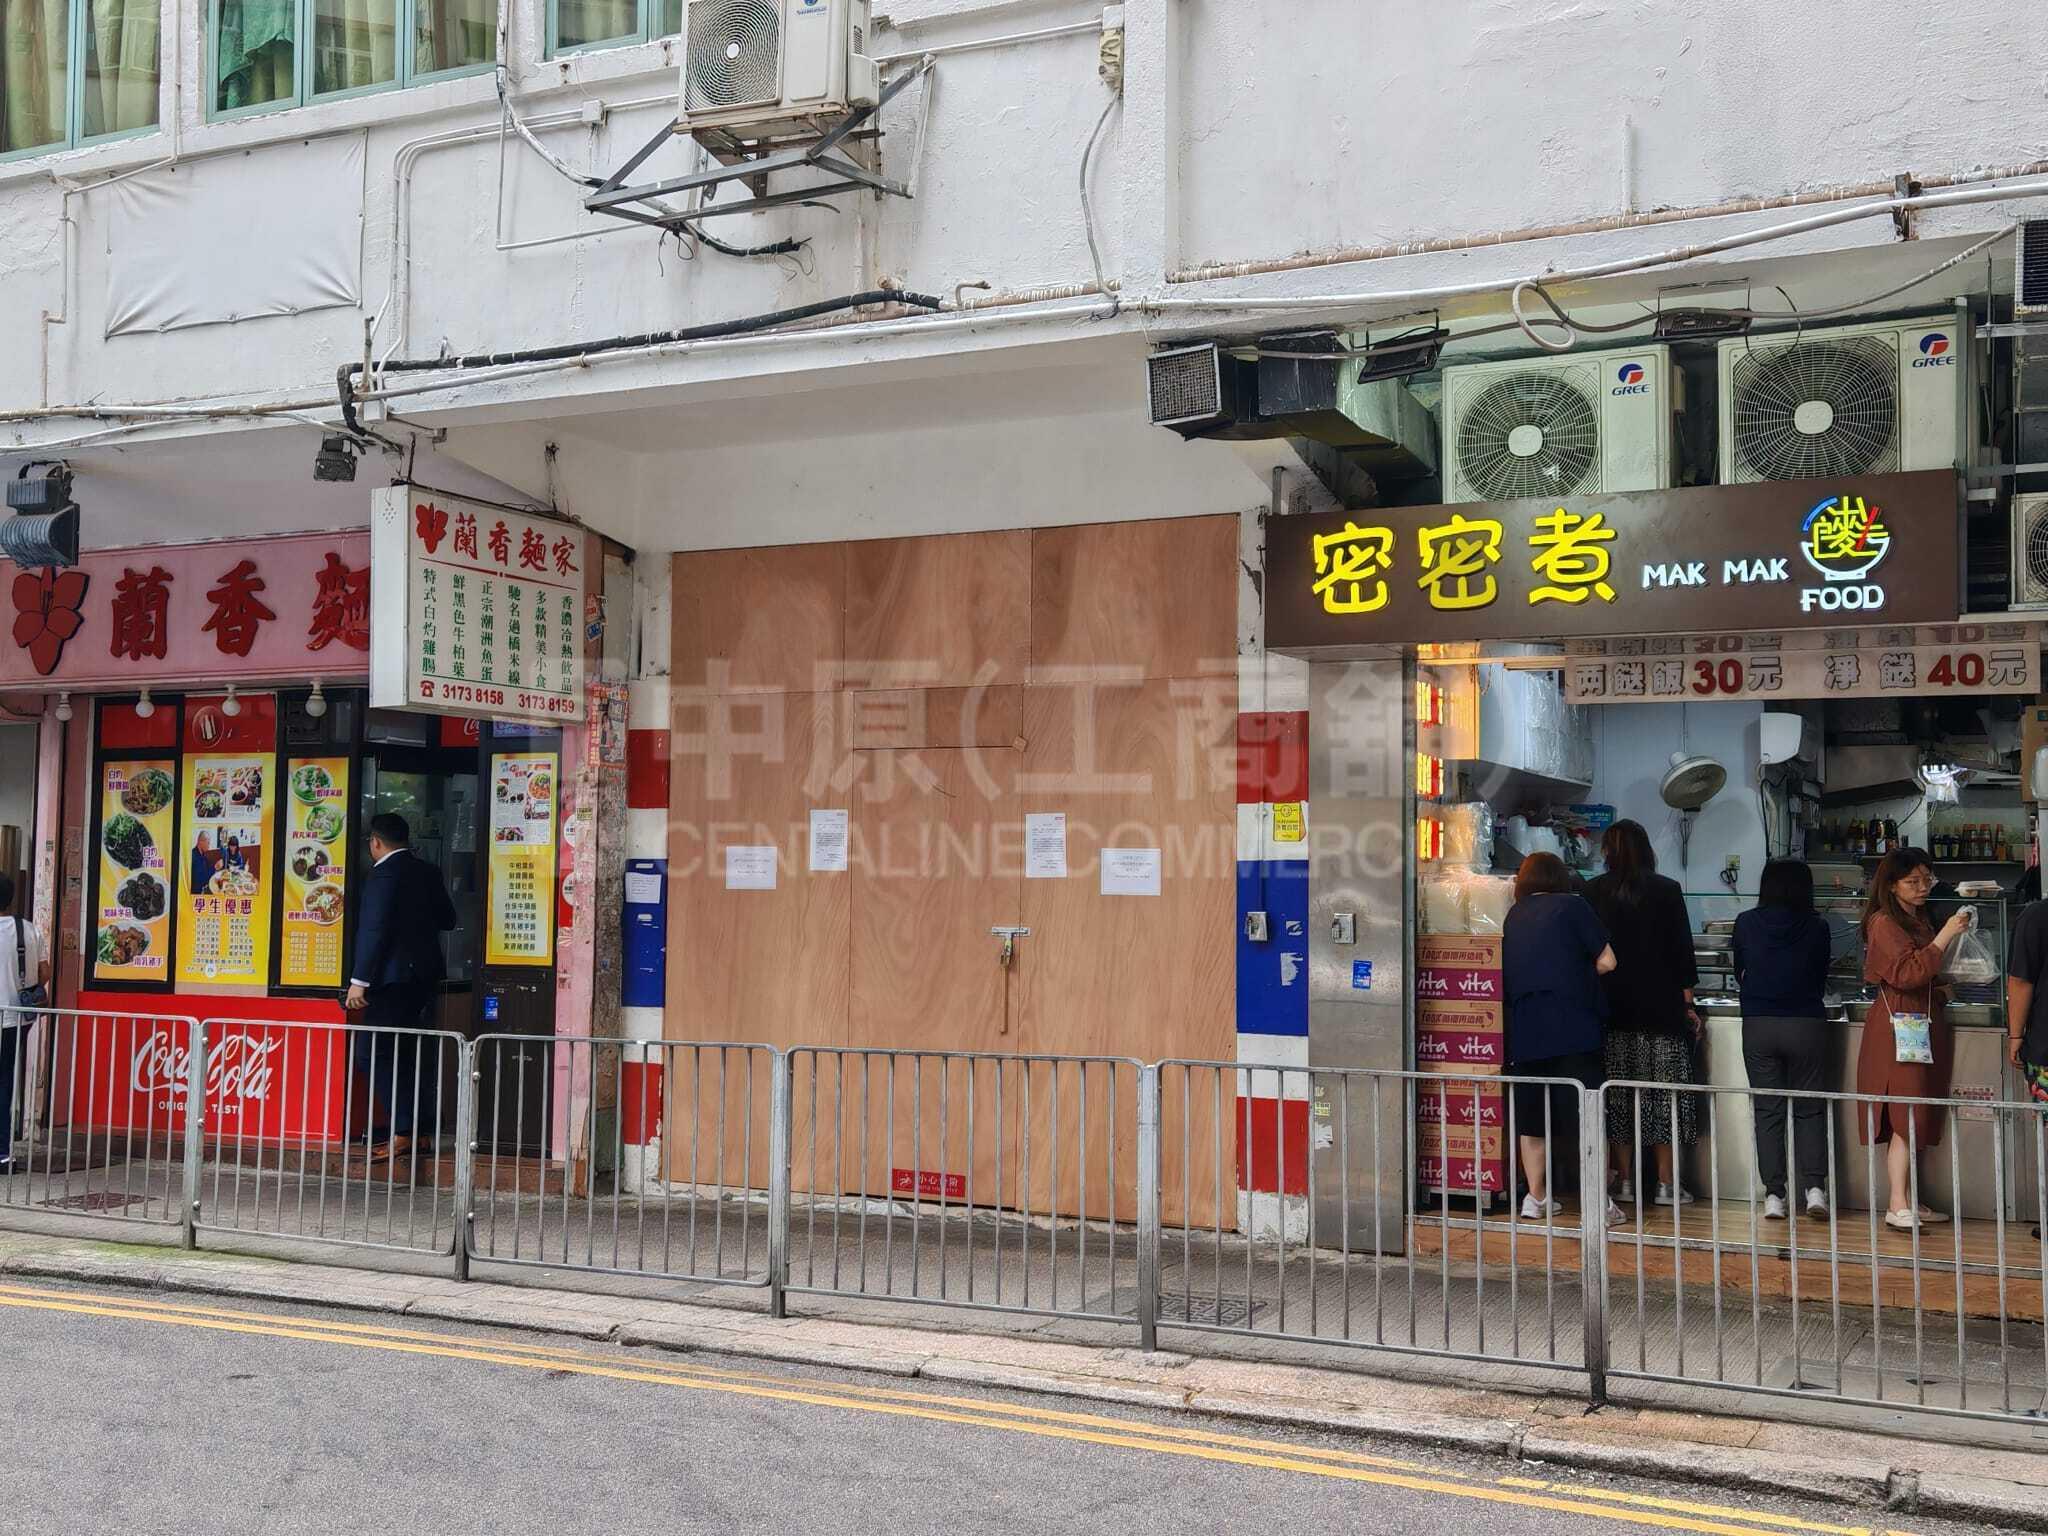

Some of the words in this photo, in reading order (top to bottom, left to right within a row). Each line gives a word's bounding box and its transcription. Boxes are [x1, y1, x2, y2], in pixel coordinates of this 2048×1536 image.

[1912, 355, 1957, 368] GREE
[1611, 384, 1651, 396] GREE
[453, 511, 579, 578] 蘭香麵家
[1312, 507, 1616, 614] 密密煮
[1642, 562, 1706, 590] MAK
[1723, 556, 1790, 583] MAK
[1800, 585, 1885, 612] FOOD
[480, 580, 493, 681] 正宗潮洲魚蛋
[442, 684, 473, 702] 3173
[475, 688, 504, 706] 8158
[518, 694, 546, 711] 3173
[548, 697, 575, 714] 8159
[194, 898, 253, 916] 學生優惠
[1459, 972, 1495, 993] vita
[1459, 1036, 1495, 1056] vita
[134, 1031, 283, 1100] CocaCola
